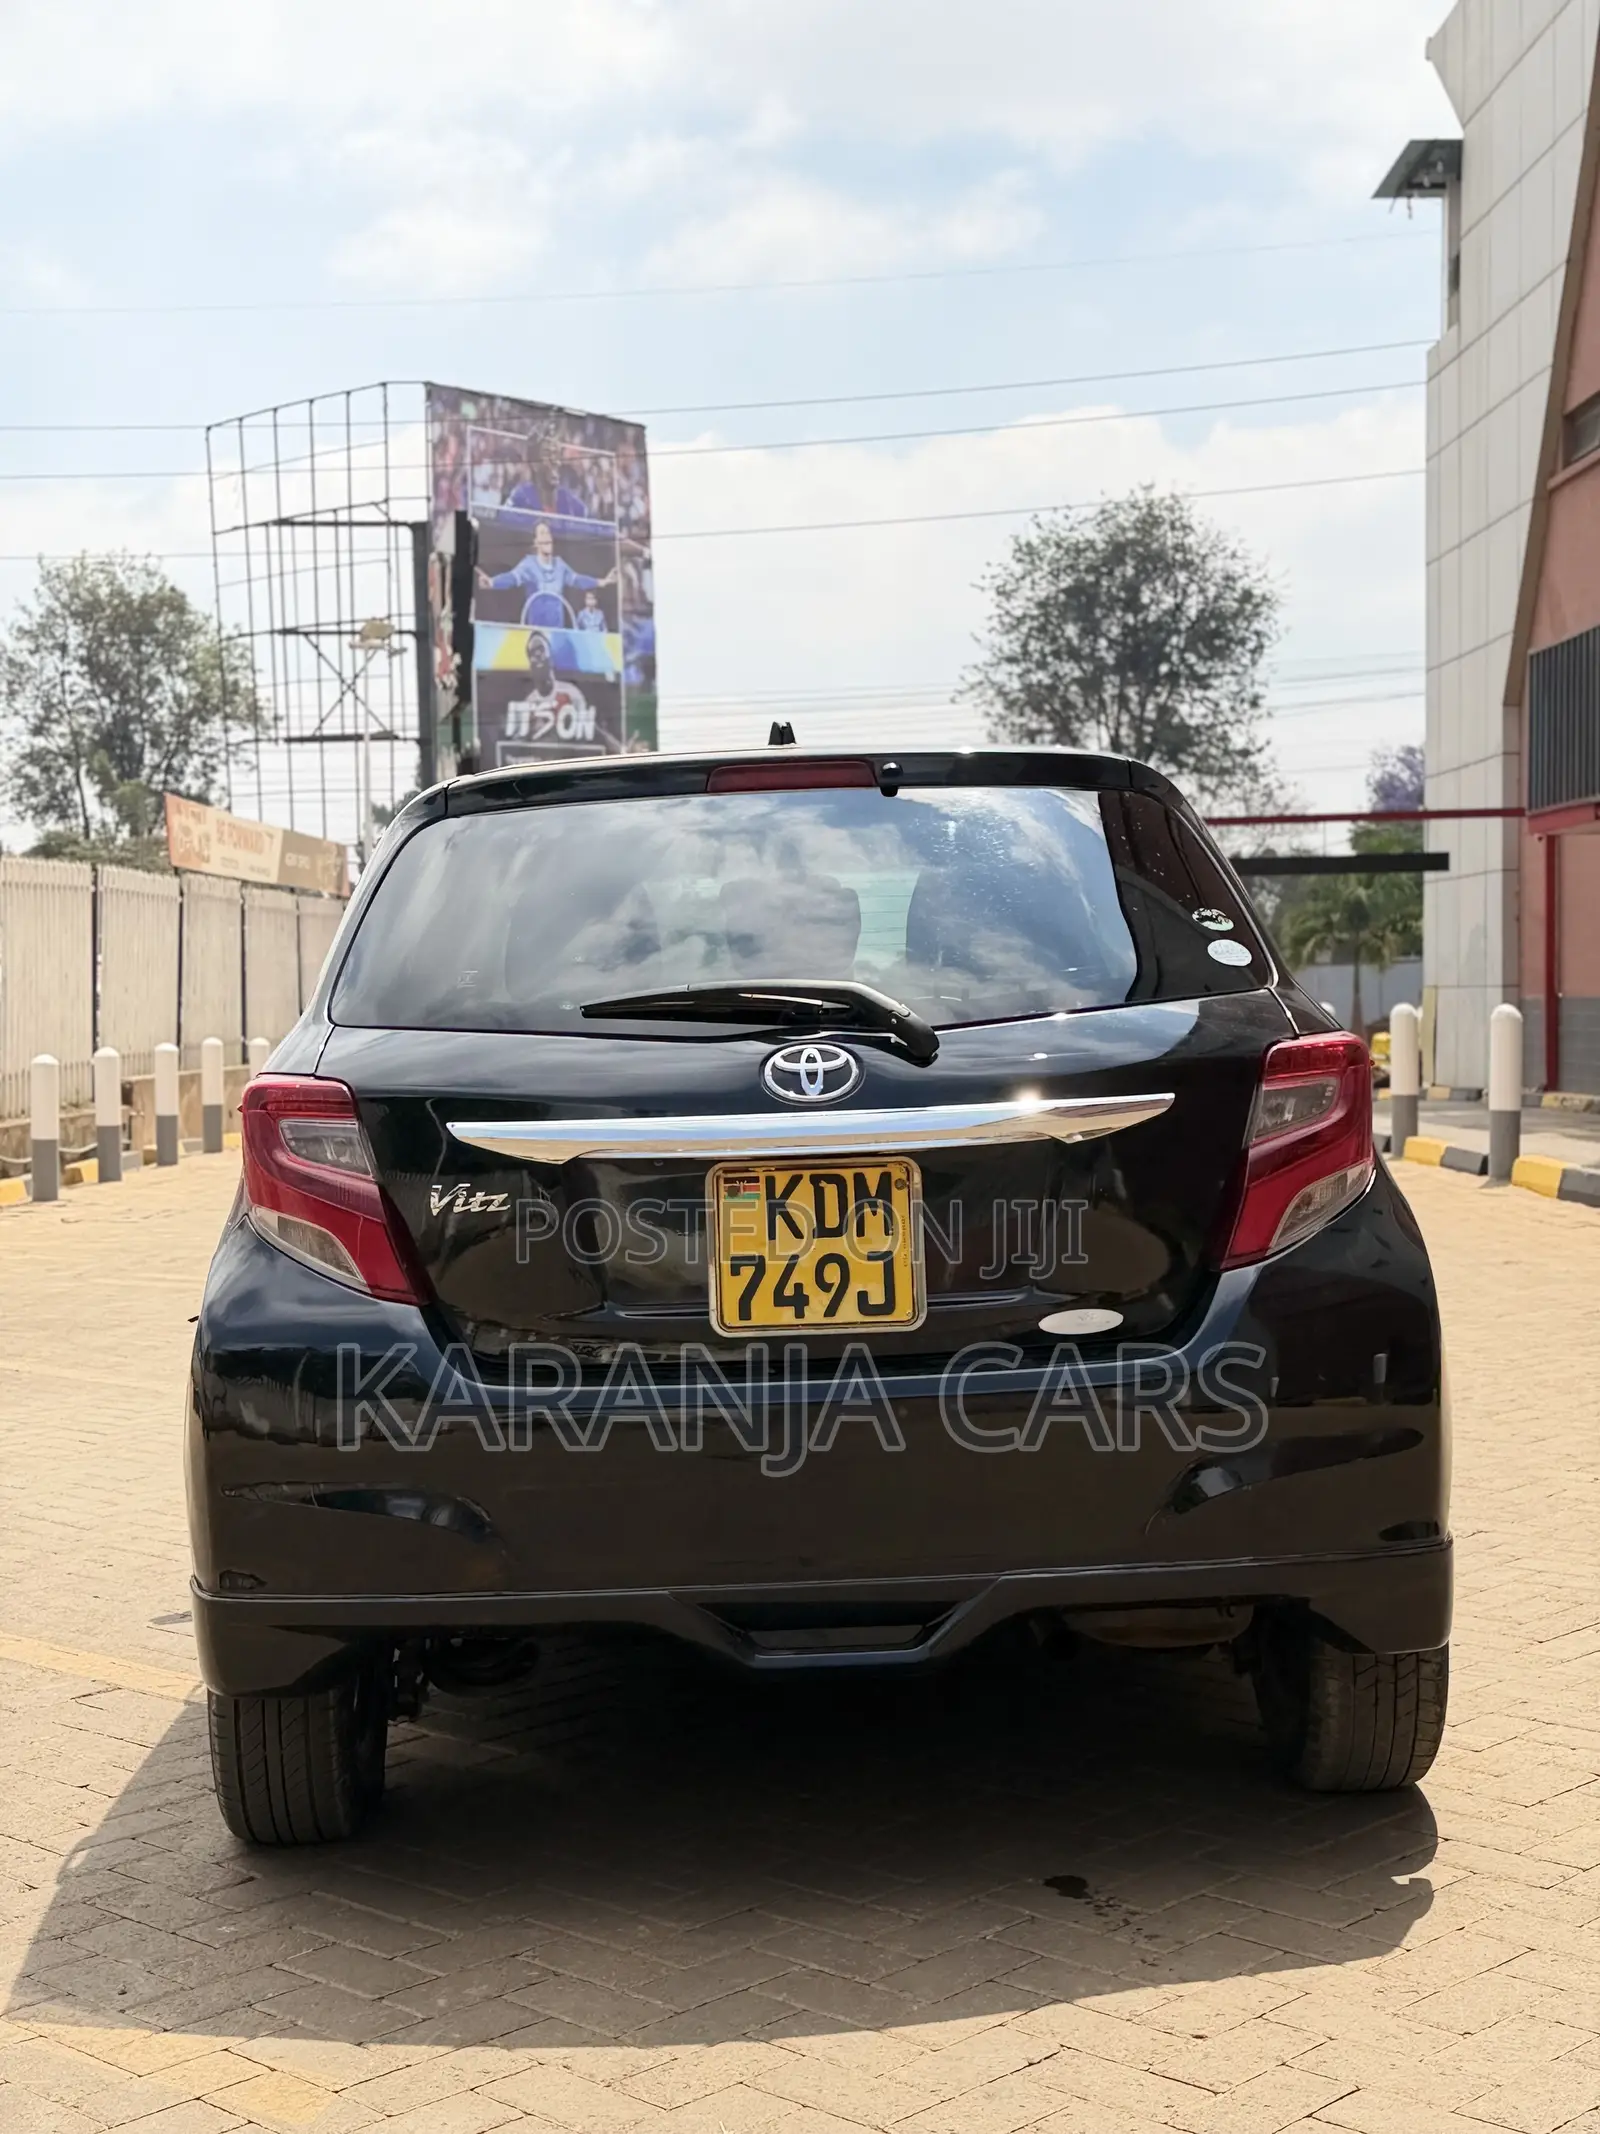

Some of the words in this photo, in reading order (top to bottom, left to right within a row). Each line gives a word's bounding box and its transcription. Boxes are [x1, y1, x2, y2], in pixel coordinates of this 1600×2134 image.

[556, 704, 597, 741] ON
[430, 1183, 511, 1217] Vitz
[764, 1171, 894, 1241] KDM
[729, 1250, 896, 1321] 749J
